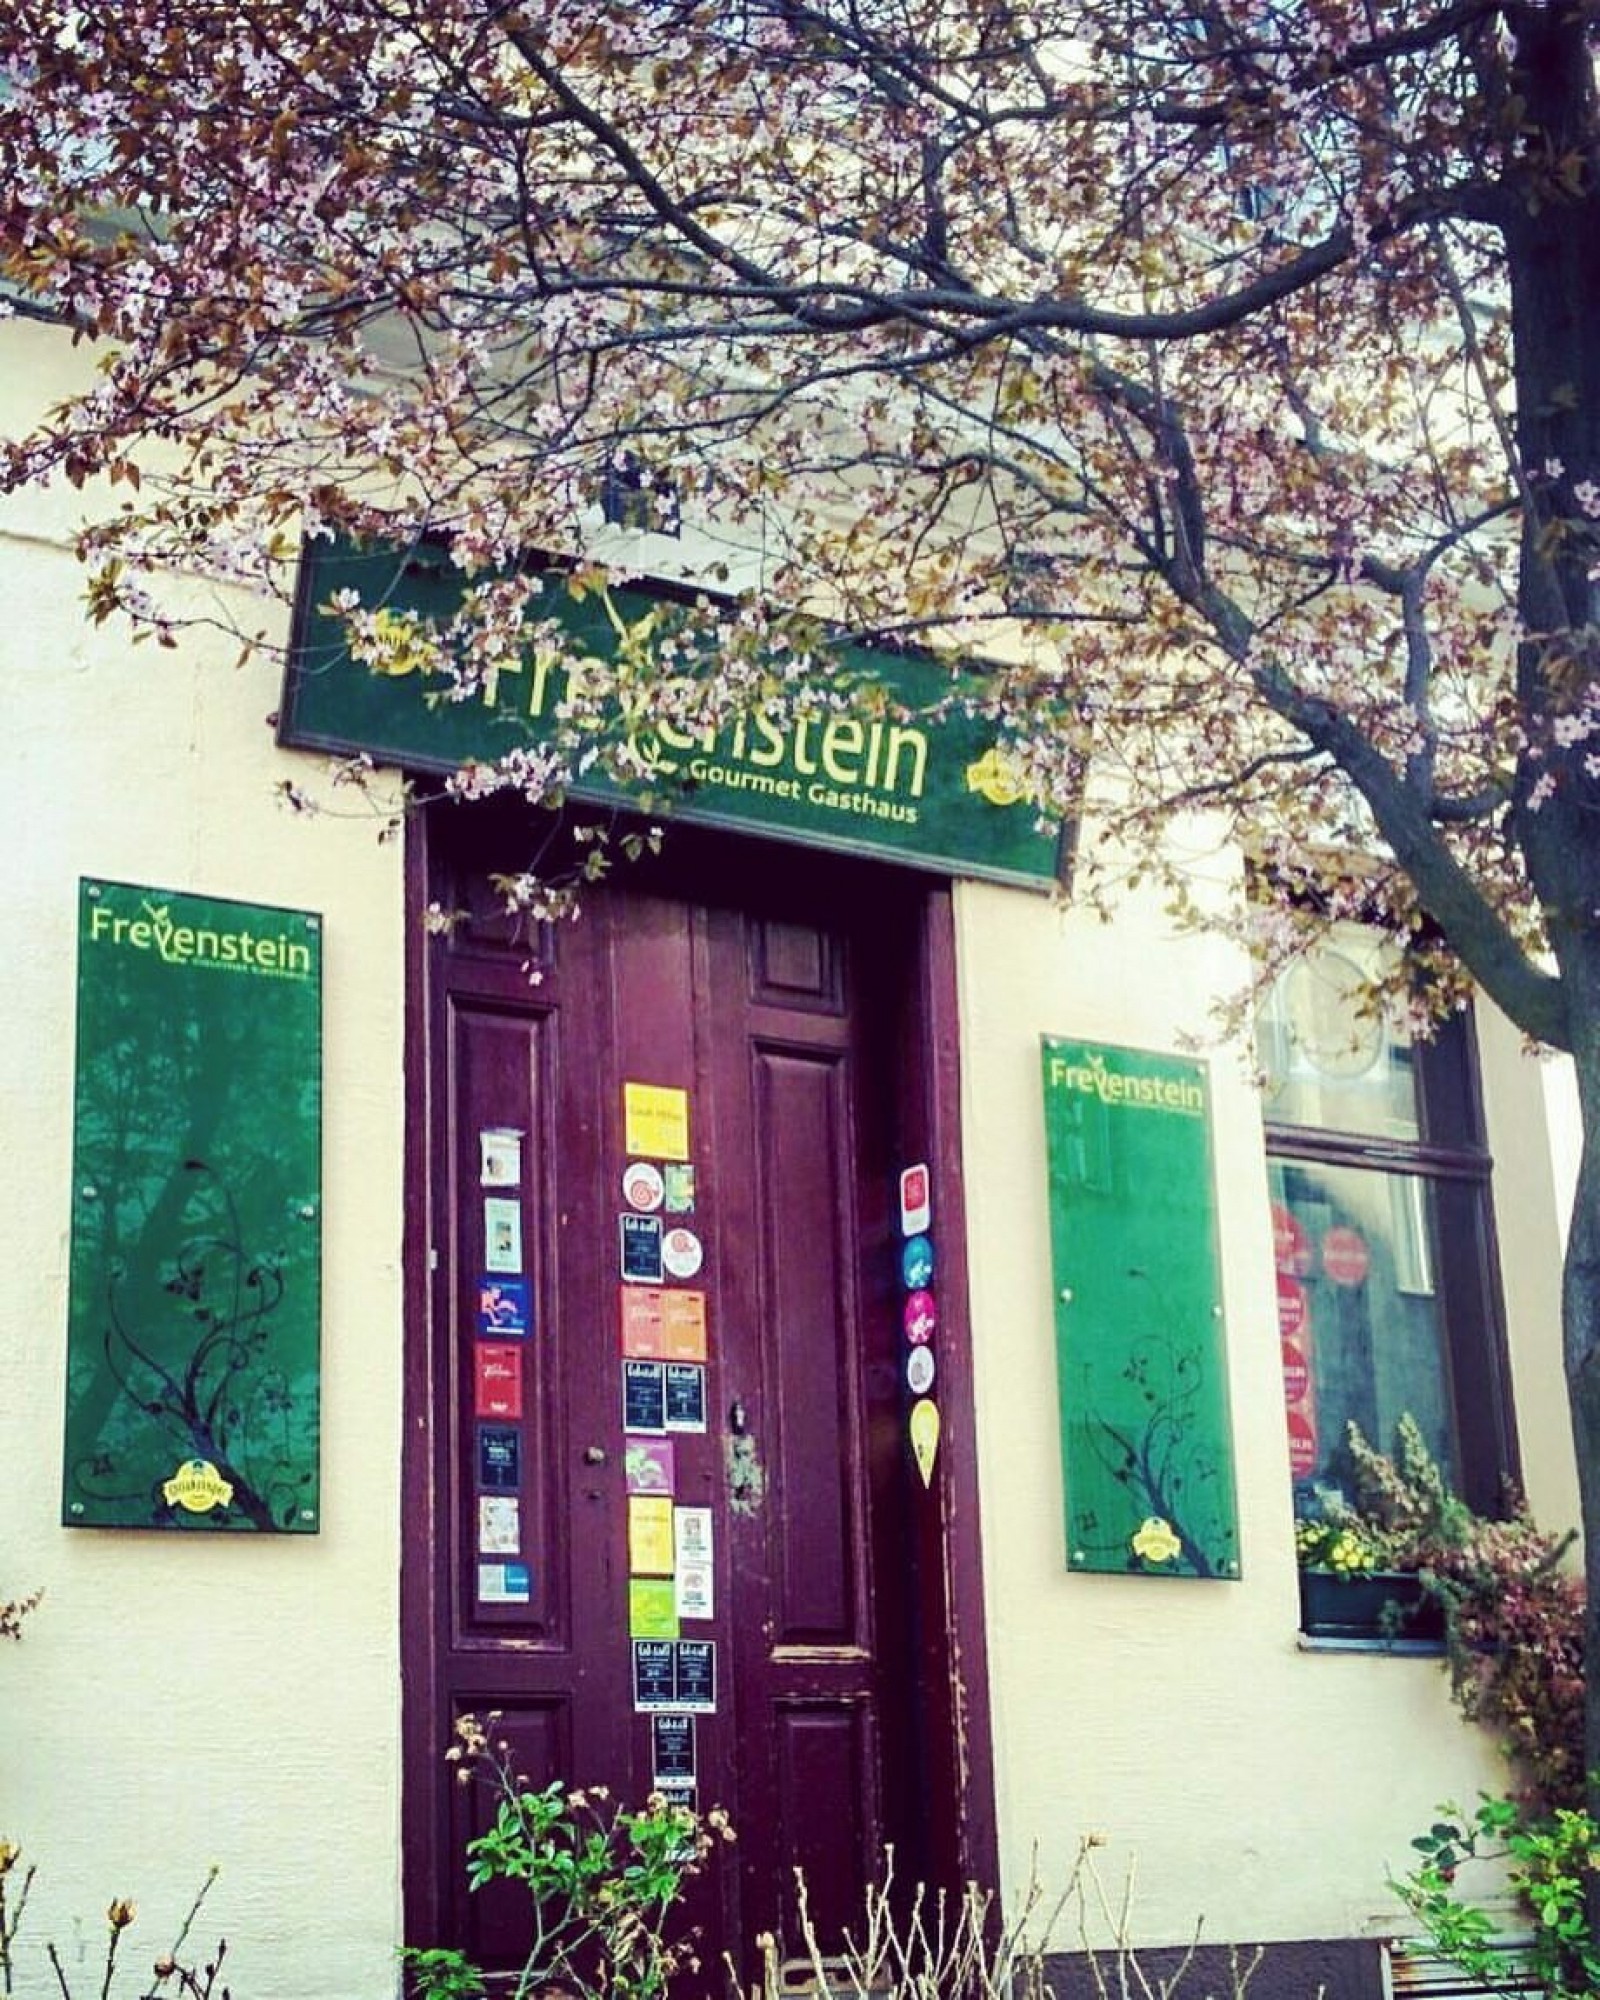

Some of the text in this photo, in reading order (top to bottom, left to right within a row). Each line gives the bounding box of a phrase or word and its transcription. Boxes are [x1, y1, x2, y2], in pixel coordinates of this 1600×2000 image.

[689, 759, 918, 824] Gourmet Gasthaus
[90, 899, 310, 971] Freyenstein
[1050, 1051, 1203, 1109] Freyenstein
